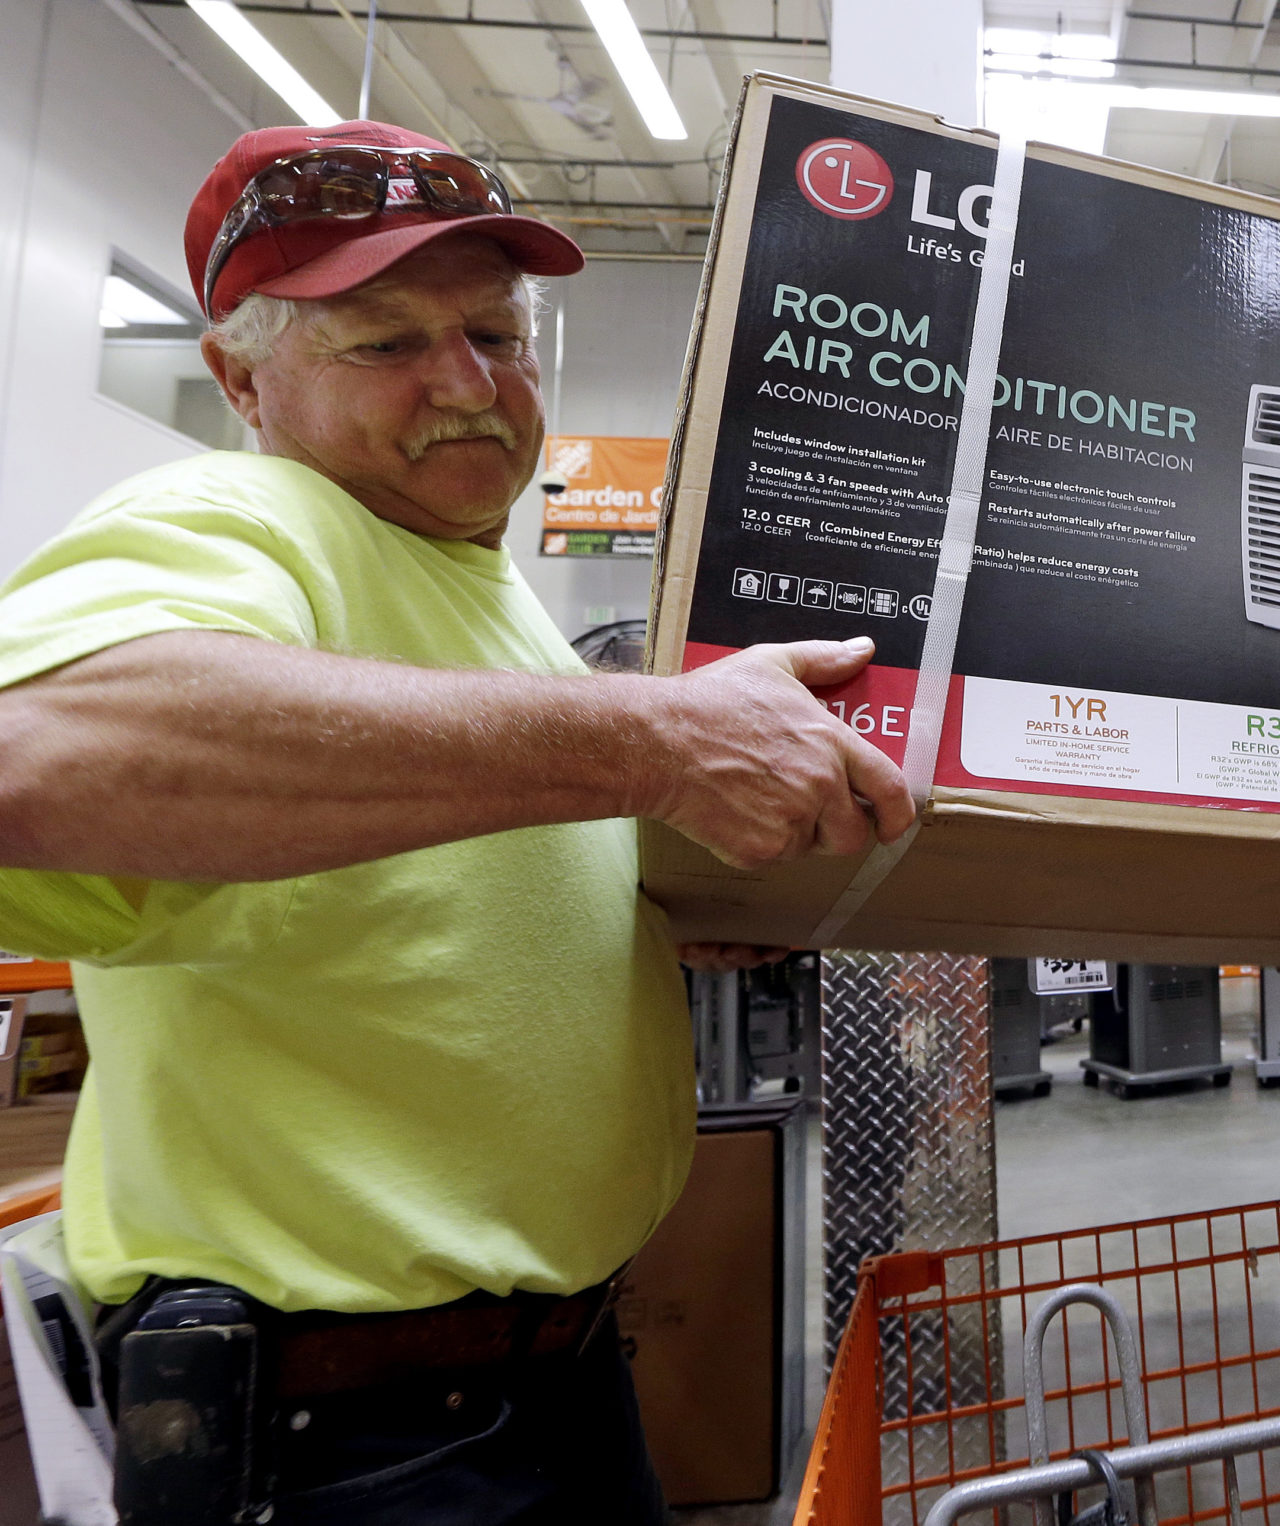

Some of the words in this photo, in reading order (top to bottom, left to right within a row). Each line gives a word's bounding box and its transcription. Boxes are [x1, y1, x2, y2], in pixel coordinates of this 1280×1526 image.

[907, 234, 962, 262] Life's
[970, 250, 1024, 276] Gd
[773, 284, 930, 348] ROOM
[764, 330, 853, 378] AIR
[758, 380, 958, 432] ACONDICIONADOR
[996, 425, 1042, 447] AIRE
[1048, 434, 1073, 452] DE
[1079, 440, 1193, 472] HABITACION
[752, 440, 784, 453] Incluye
[784, 446, 810, 458] juego
[812, 450, 823, 460] de
[824, 453, 871, 468] instalación
[872, 462, 884, 470] en
[885, 464, 918, 476] ventana
[754, 427, 802, 445] Includes
[804, 438, 846, 454] window
[848, 445, 910, 464] installation
[912, 456, 926, 467] kit
[547, 485, 644, 507] Garden
[746, 484, 780, 498] función
[781, 490, 792, 500] de
[794, 494, 850, 510] enfriamiento
[852, 504, 901, 518] automático
[747, 474, 754, 482] 3
[756, 476, 808, 492] velocidades
[809, 486, 821, 494] de
[822, 488, 878, 504] enfriamiento
[879, 498, 884, 506] y
[886, 498, 893, 506] 3
[894, 499, 905, 508] de
[748, 462, 758, 472] 3
[760, 464, 802, 482] cooling
[804, 472, 814, 482] &
[816, 474, 826, 484] 3
[828, 476, 847, 488] fan
[849, 481, 889, 495] speeds
[890, 486, 914, 499] with
[916, 490, 944, 504] Auto
[988, 482, 1028, 495] Controles
[1029, 488, 1058, 500] táctiles
[1059, 494, 1106, 508] electrónicos
[1107, 500, 1132, 511] fáciles
[1133, 505, 1143, 513] de
[1144, 508, 1160, 516] usar
[990, 470, 1052, 488] Easy-to-use
[1054, 481, 1104, 497] electronic
[1106, 490, 1134, 502] touch
[1136, 494, 1176, 508] controls
[546, 506, 598, 523] Centro
[598, 508, 619, 523] de
[988, 502, 1034, 518] Restarts
[1036, 511, 1104, 530] automatically
[1106, 522, 1132, 533] after
[1133, 526, 1164, 538] power
[1164, 529, 1196, 544] failure
[742, 508, 771, 522] 12.0
[776, 514, 812, 529] CEER
[820, 520, 885, 541] (Combined
[887, 532, 925, 548] Energy
[974, 545, 1005, 560] Ratio)
[1007, 550, 1036, 564] helps
[1038, 555, 1073, 568] reduce
[1075, 562, 1110, 576] energy
[1112, 566, 1139, 578] costs
[1049, 694, 1107, 722] 1YR
[1026, 720, 1069, 734] PARTS
[1072, 724, 1082, 736] &
[1085, 726, 1129, 740] LABOR
[1026, 738, 1058, 748] LIMITED
[1060, 741, 1095, 751] IN-HOME
[1096, 744, 1130, 754] SERVICE
[1055, 750, 1102, 761] WARRANTY
